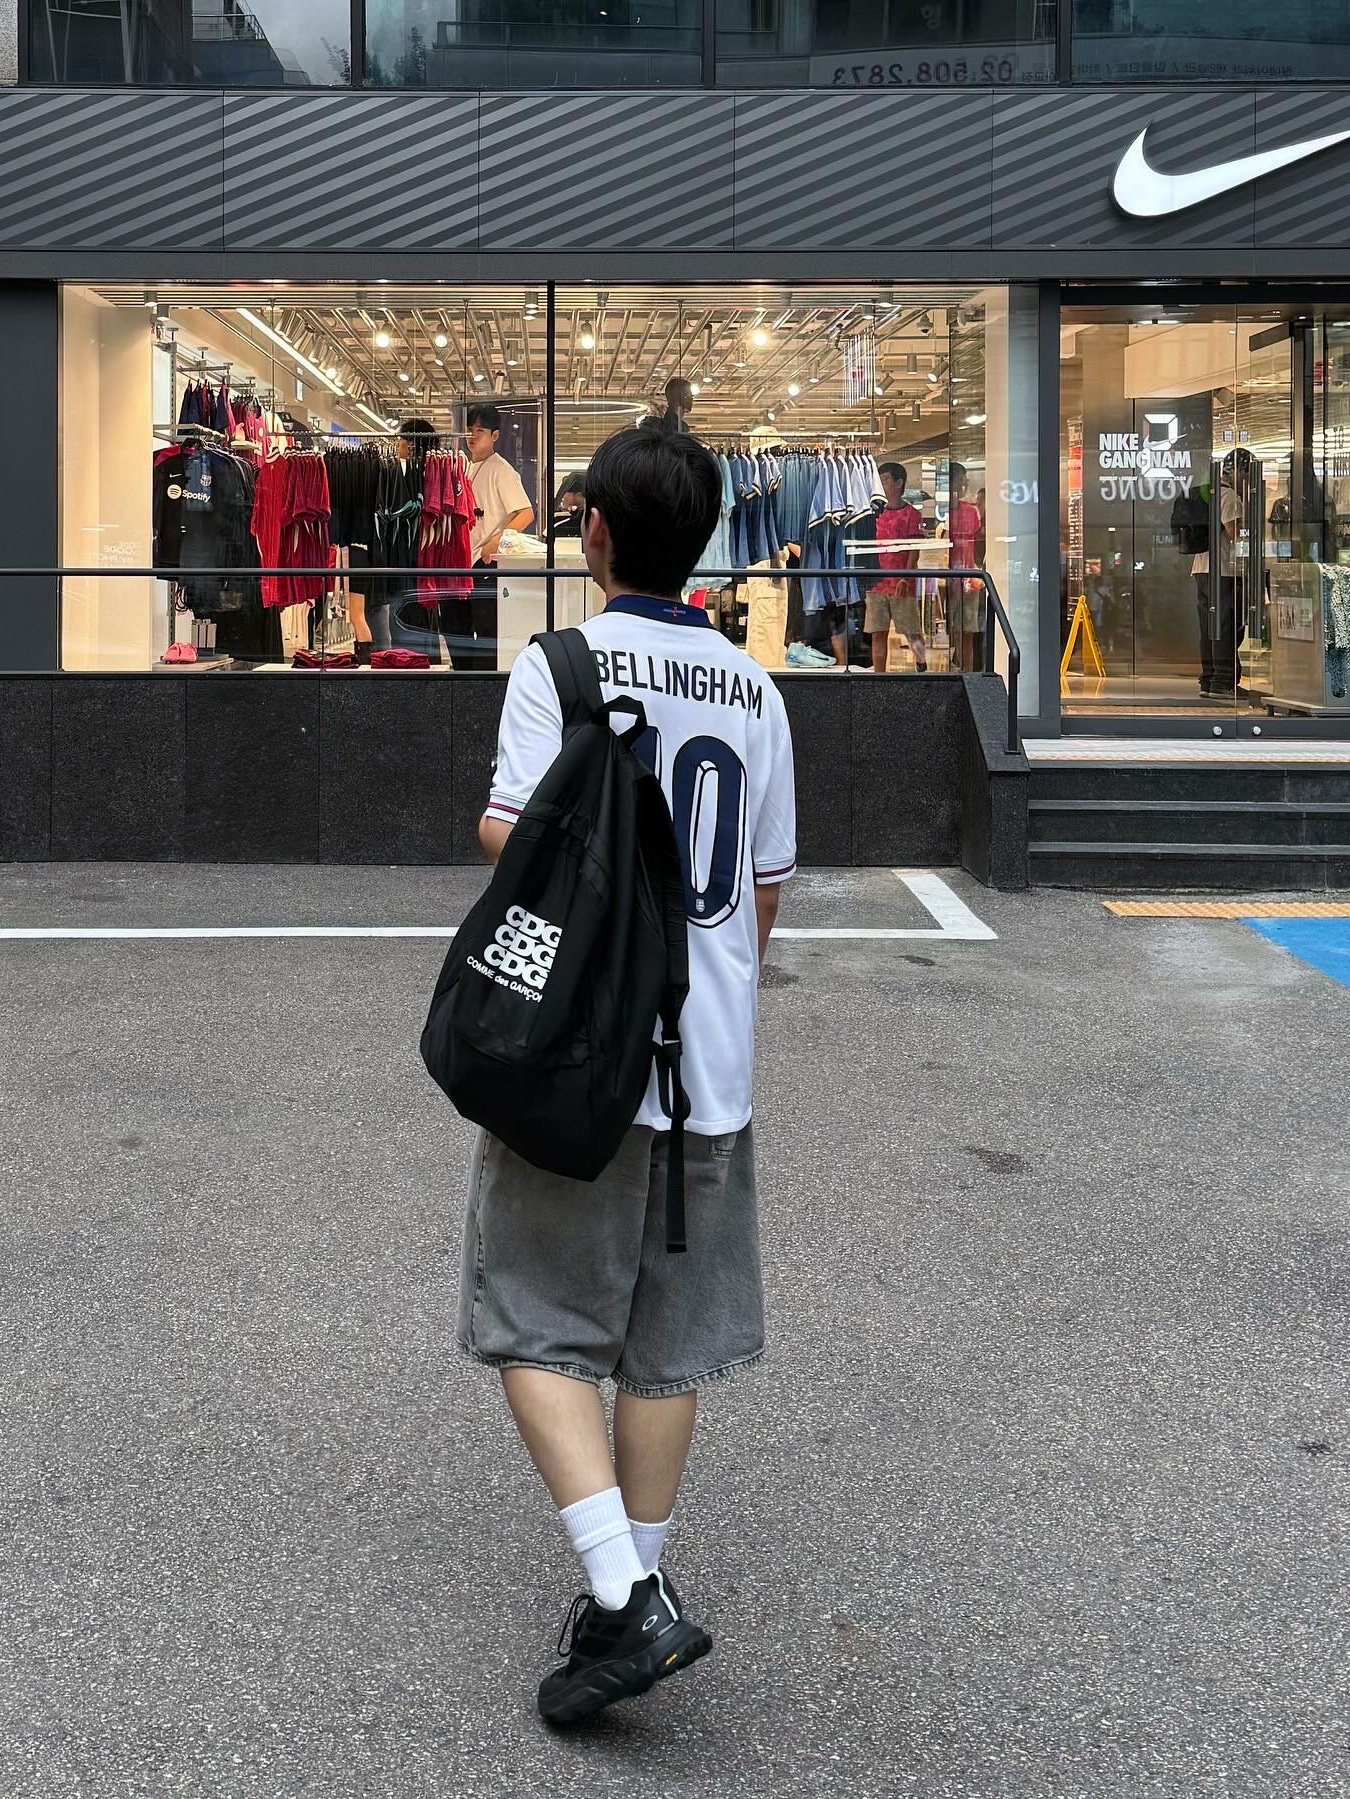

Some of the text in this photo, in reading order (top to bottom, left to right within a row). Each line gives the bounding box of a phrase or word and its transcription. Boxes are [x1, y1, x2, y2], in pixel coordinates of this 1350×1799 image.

[1099, 433, 1139, 450] NIKE
[1099, 450, 1192, 469] GANGNAM
[182, 489, 211, 503] Spotify
[594, 649, 763, 719] BELLINGHAM
[505, 904, 563, 948] CDG
[494, 924, 557, 970] CDG
[466, 955, 496, 979] COMME
[494, 975, 510, 987] des
[483, 943, 551, 990] CDG
